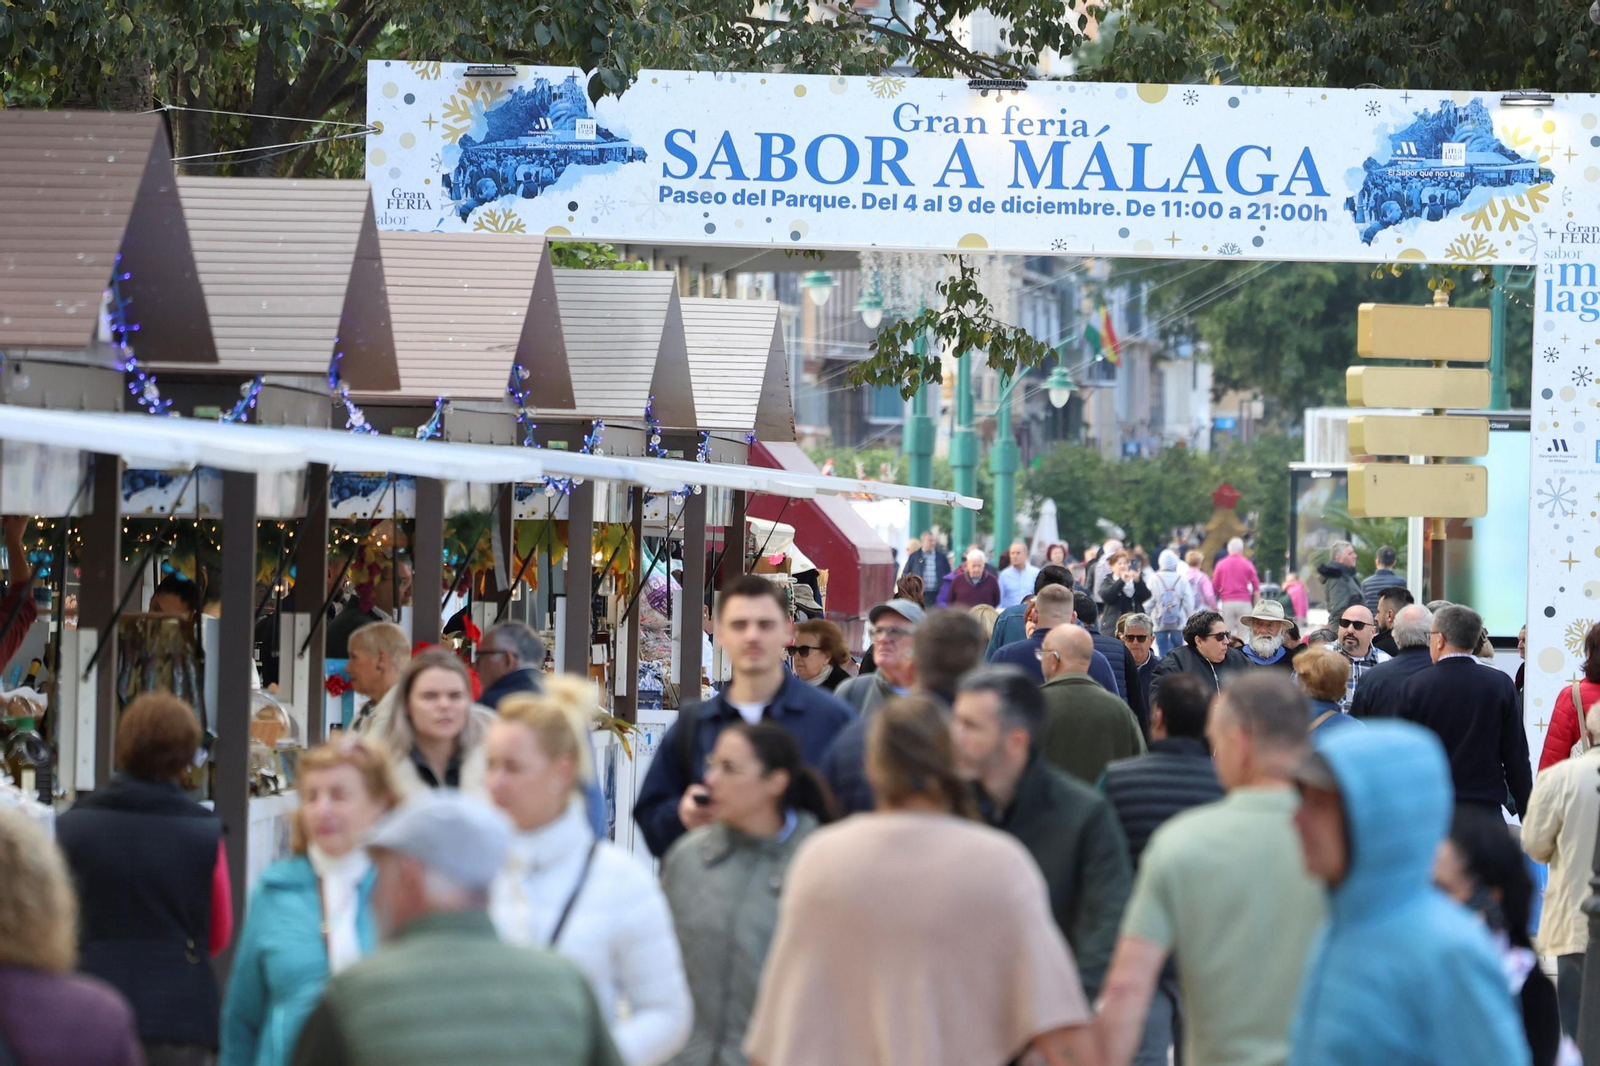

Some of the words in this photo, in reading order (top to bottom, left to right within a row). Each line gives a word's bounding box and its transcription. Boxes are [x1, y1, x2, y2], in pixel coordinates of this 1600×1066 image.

[893, 102, 988, 135] Gran
[1001, 105, 1090, 137] feria
[662, 128, 915, 187] SABOR
[932, 138, 985, 189] A
[1007, 124, 1331, 197] MÁLAGA
[1396, 169, 1418, 177] Sabor
[391, 187, 425, 199] Gran
[386, 198, 433, 210] FERIA
[659, 185, 727, 207] Paseo
[733, 188, 766, 208] del
[771, 189, 858, 213] Parque.
[861, 192, 899, 211] Del
[903, 194, 918, 211] 4
[923, 195, 943, 213] al
[948, 195, 963, 213] 9
[968, 196, 996, 214] de
[1001, 195, 1122, 217] diciembre.
[1126, 199, 1156, 217] De
[1161, 200, 1224, 219] 11:00
[1228, 206, 1242, 220] a
[1247, 202, 1328, 222] 21:00h
[377, 211, 409, 225] abor
[1565, 221, 1600, 232] Gran
[1561, 232, 1600, 243] FERI
[1544, 245, 1583, 259] sabor
[1544, 262, 1554, 274] a
[1557, 263, 1600, 286] m
[1544, 279, 1600, 322] lag
[645, 732, 652, 746] 1
